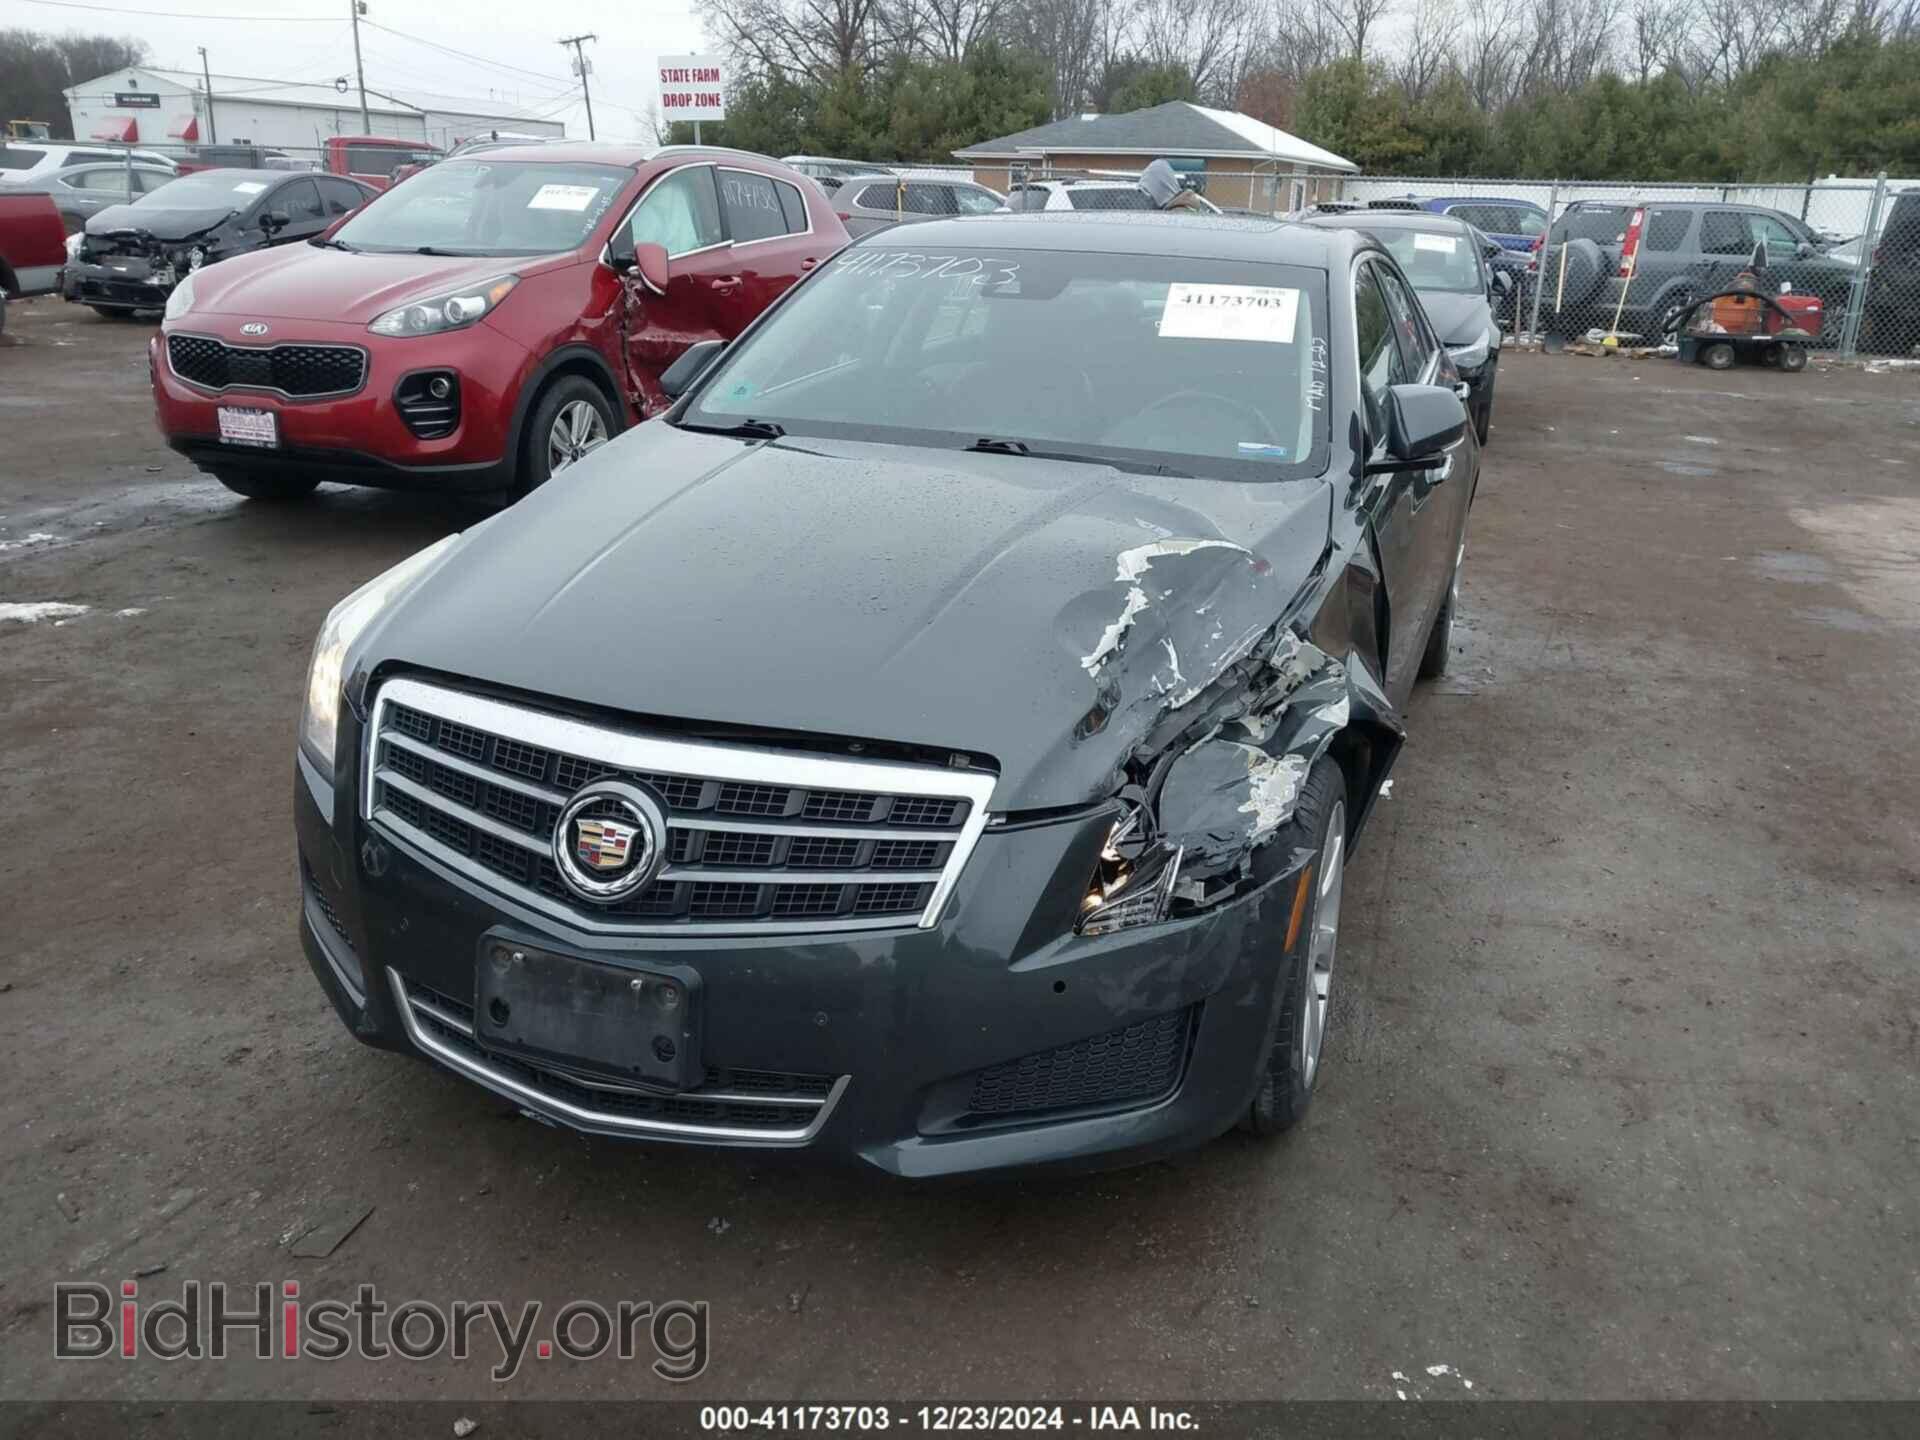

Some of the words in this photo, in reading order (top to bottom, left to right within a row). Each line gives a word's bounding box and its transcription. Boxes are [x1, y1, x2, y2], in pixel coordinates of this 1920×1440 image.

[660, 68, 690, 83] STATE
[692, 67, 720, 83] FARM
[663, 93, 692, 107] DROP
[694, 93, 721, 107] ZONE
[1179, 294, 1281, 308] 41173703
[242, 322, 267, 335] KIA
